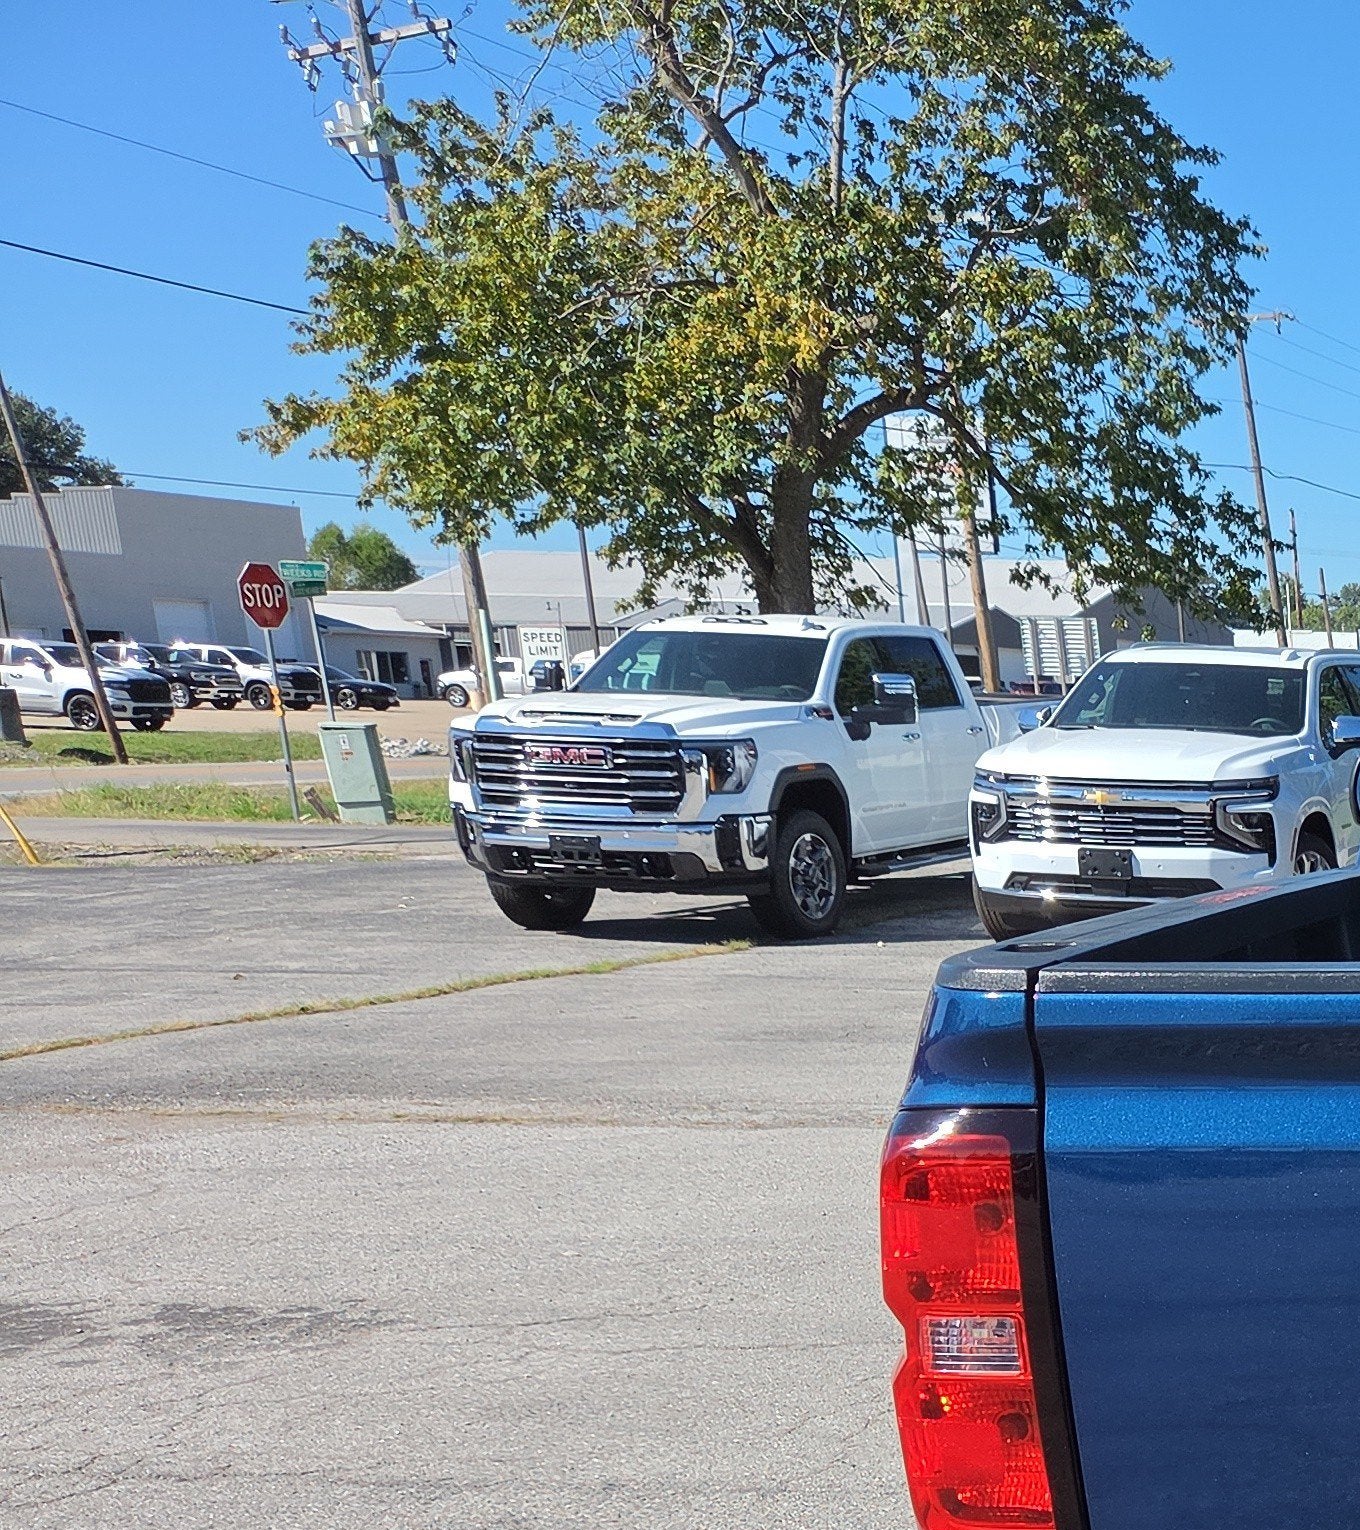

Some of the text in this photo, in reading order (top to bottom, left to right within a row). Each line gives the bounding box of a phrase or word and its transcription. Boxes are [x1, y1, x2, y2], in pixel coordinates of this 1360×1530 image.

[243, 583, 284, 608] STOP
[523, 632, 562, 643] SPEED
[528, 645, 559, 656] LIMIT
[526, 747, 605, 764] GMC
